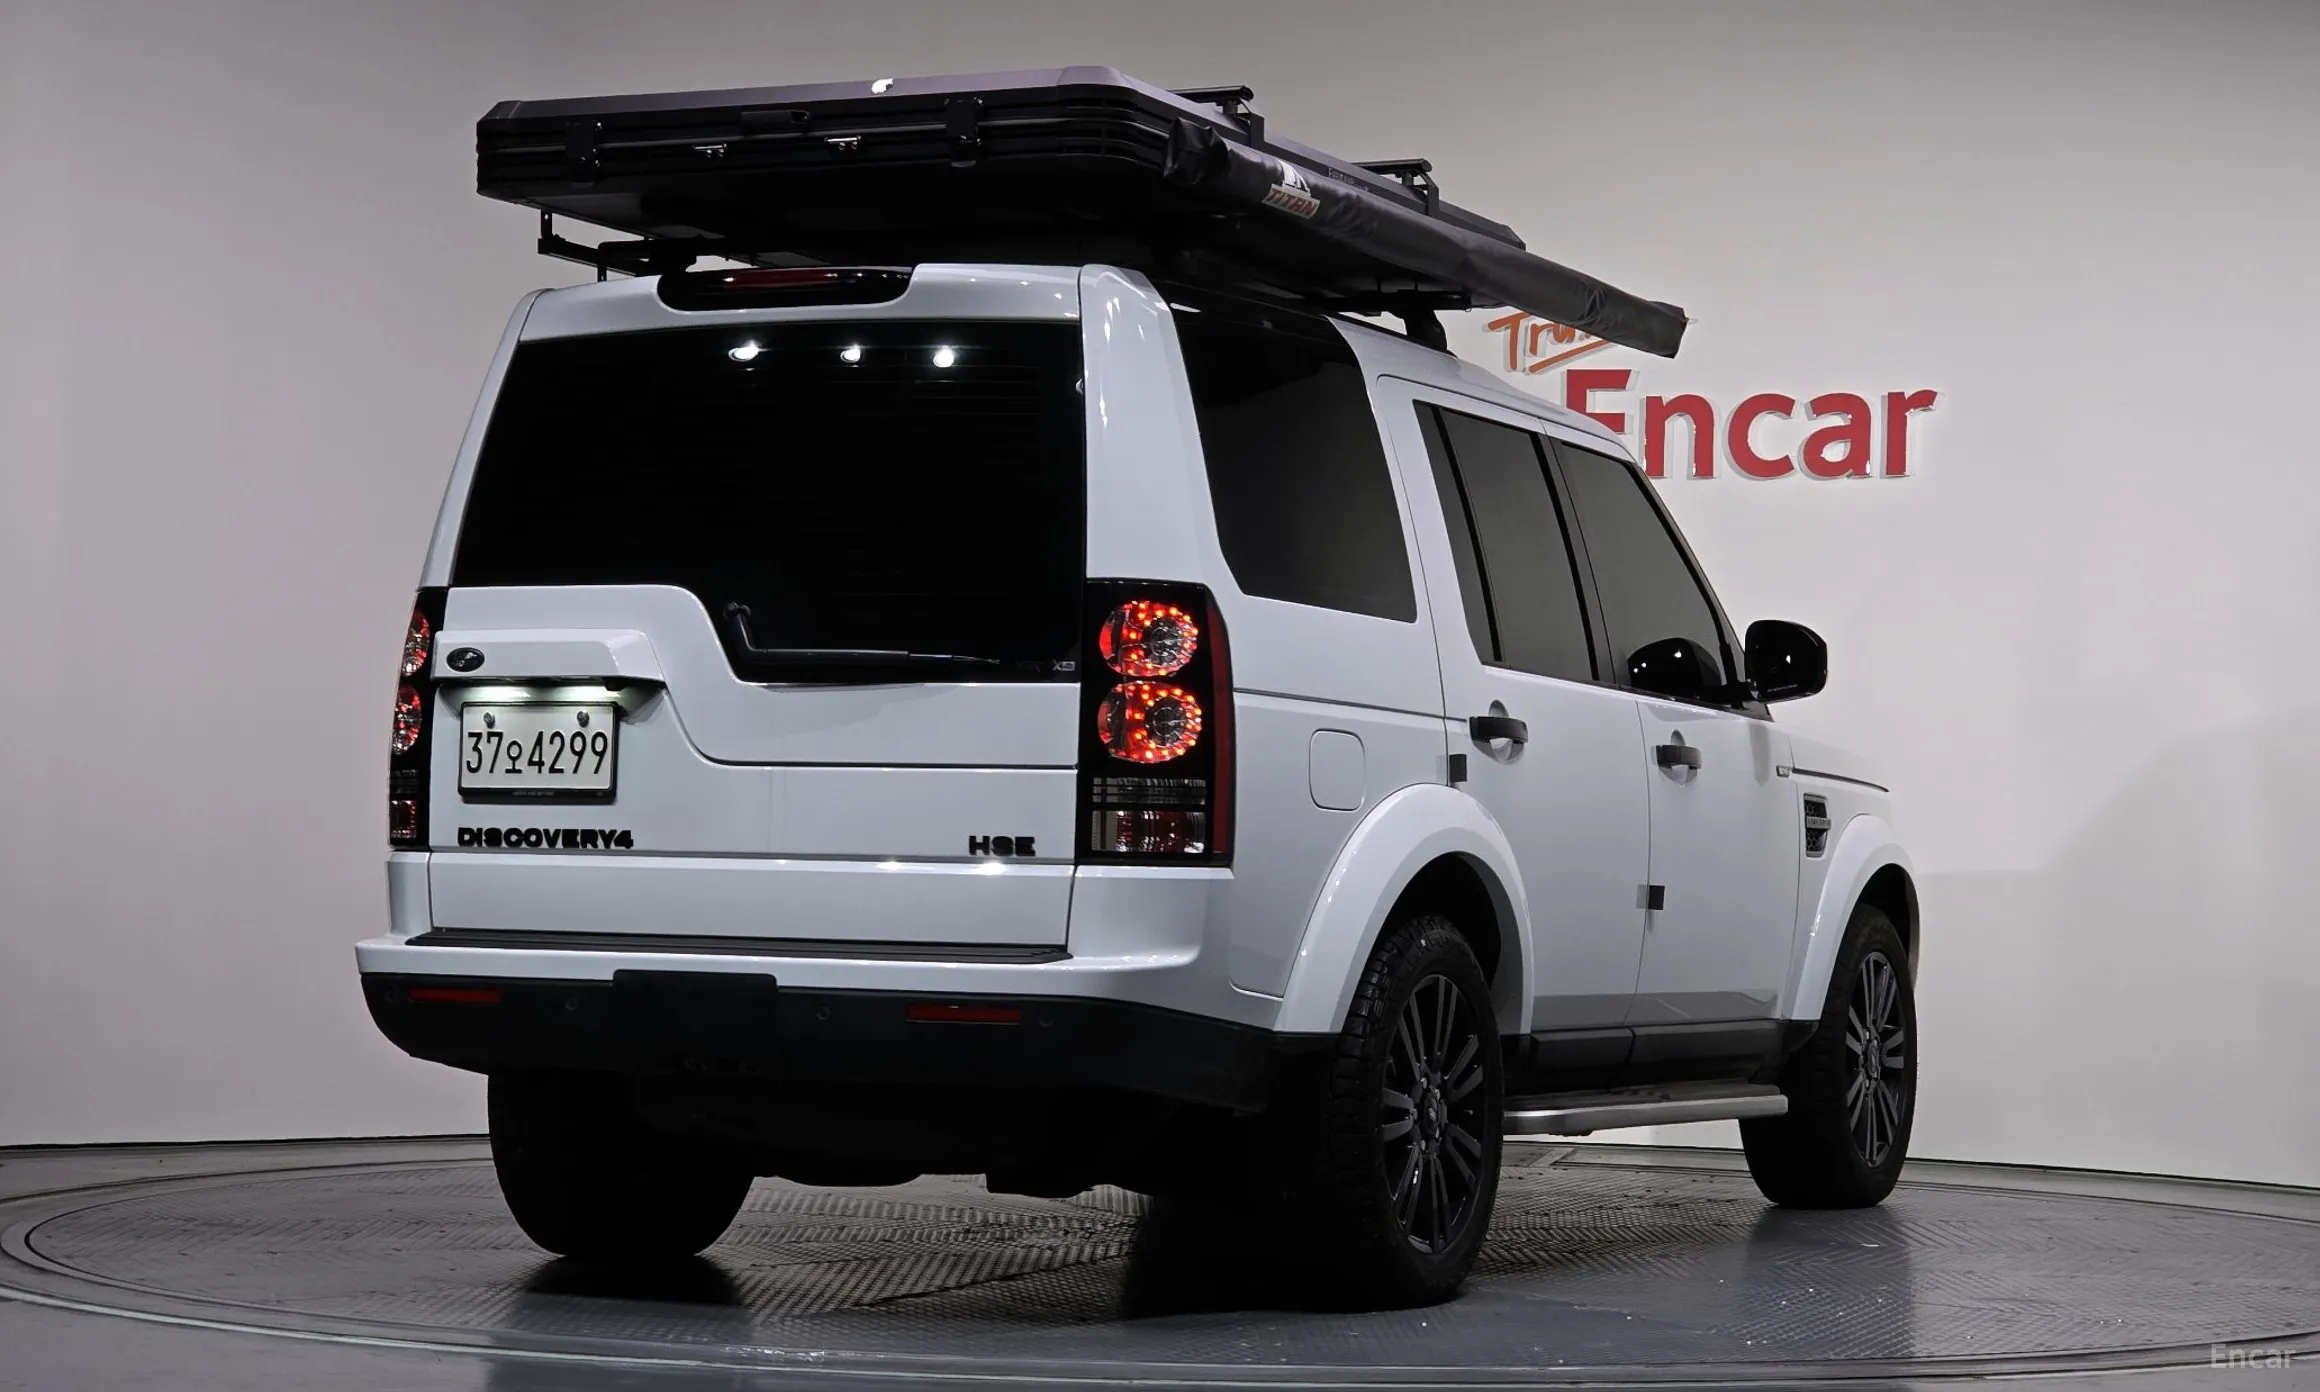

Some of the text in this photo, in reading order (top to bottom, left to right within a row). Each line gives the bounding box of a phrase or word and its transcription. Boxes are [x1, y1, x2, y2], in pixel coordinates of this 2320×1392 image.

[1265, 187, 1317, 216] TITAN
[1565, 368, 1938, 478] Encar
[466, 731, 609, 774] 37오4299
[968, 835, 1036, 857] HSE
